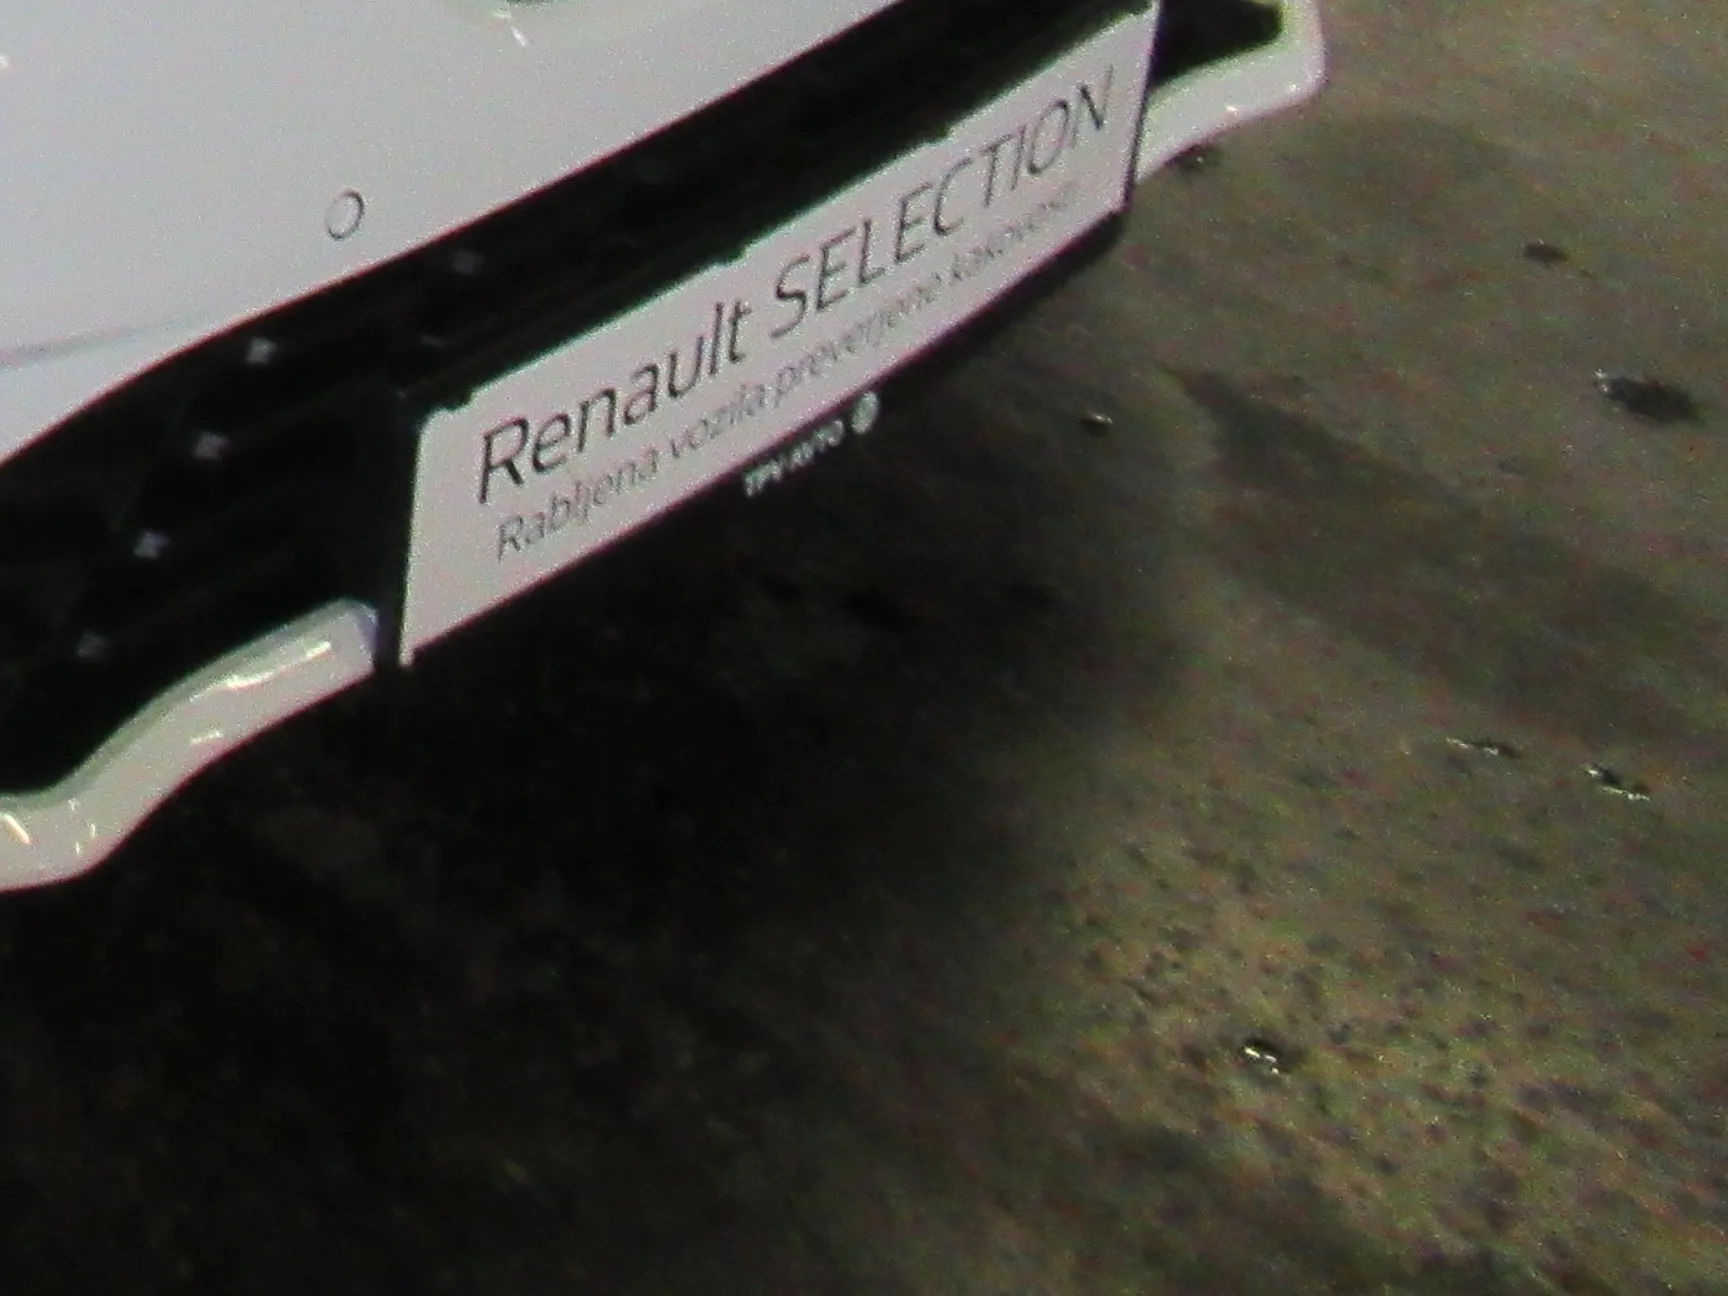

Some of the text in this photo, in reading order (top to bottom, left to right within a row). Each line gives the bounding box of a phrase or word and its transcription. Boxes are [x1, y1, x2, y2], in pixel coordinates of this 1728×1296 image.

[477, 66, 1116, 504] Renault SELECTION
[497, 445, 659, 562] Rabljena
[667, 378, 770, 458] vozila
